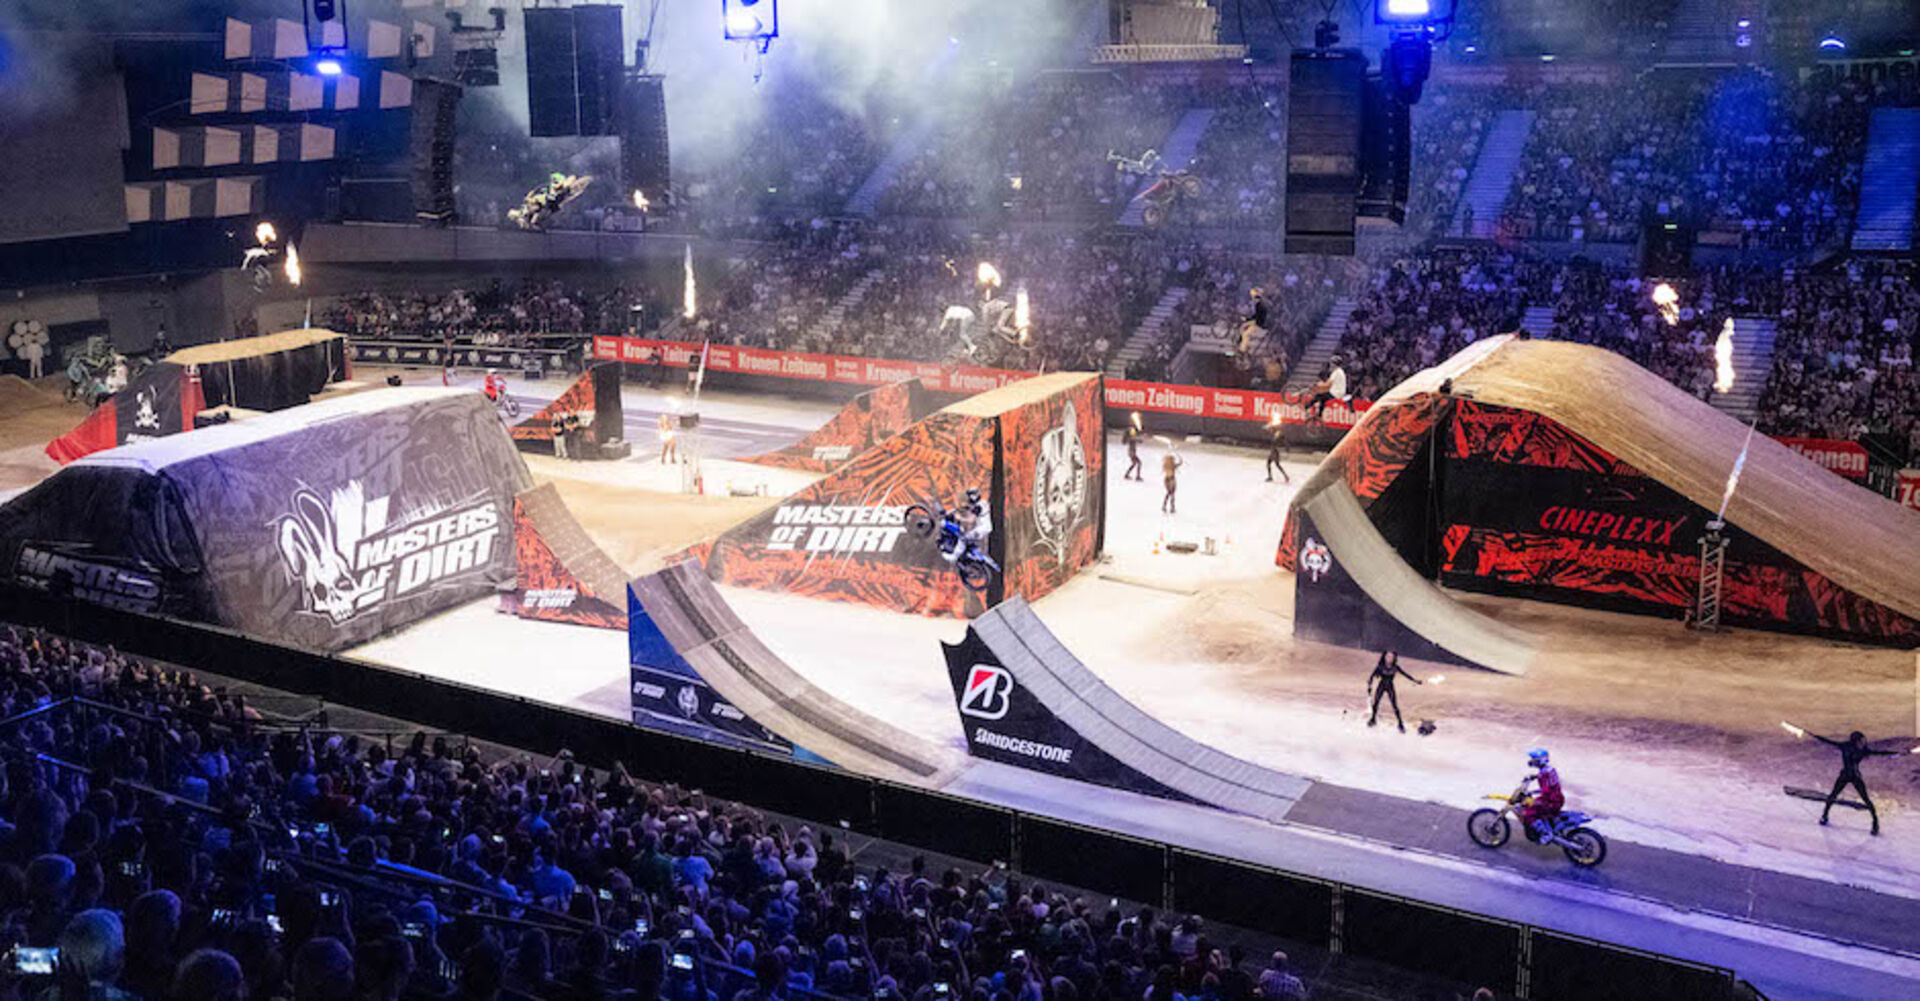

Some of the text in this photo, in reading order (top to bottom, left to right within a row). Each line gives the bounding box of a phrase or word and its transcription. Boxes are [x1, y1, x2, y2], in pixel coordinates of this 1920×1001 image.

[738, 352, 827, 379] Kronen Zeitung
[950, 371, 997, 389] Kronen
[1104, 387, 1204, 414] ronen Zeitung
[772, 505, 907, 524] MASTERS
[1540, 507, 1688, 546] CINEPLEXX
[355, 502, 499, 571] MASTERS
[768, 526, 908, 552] OF DIRT
[360, 526, 499, 595] OF DIRT
[974, 727, 1073, 764] BRIDGESTONE
